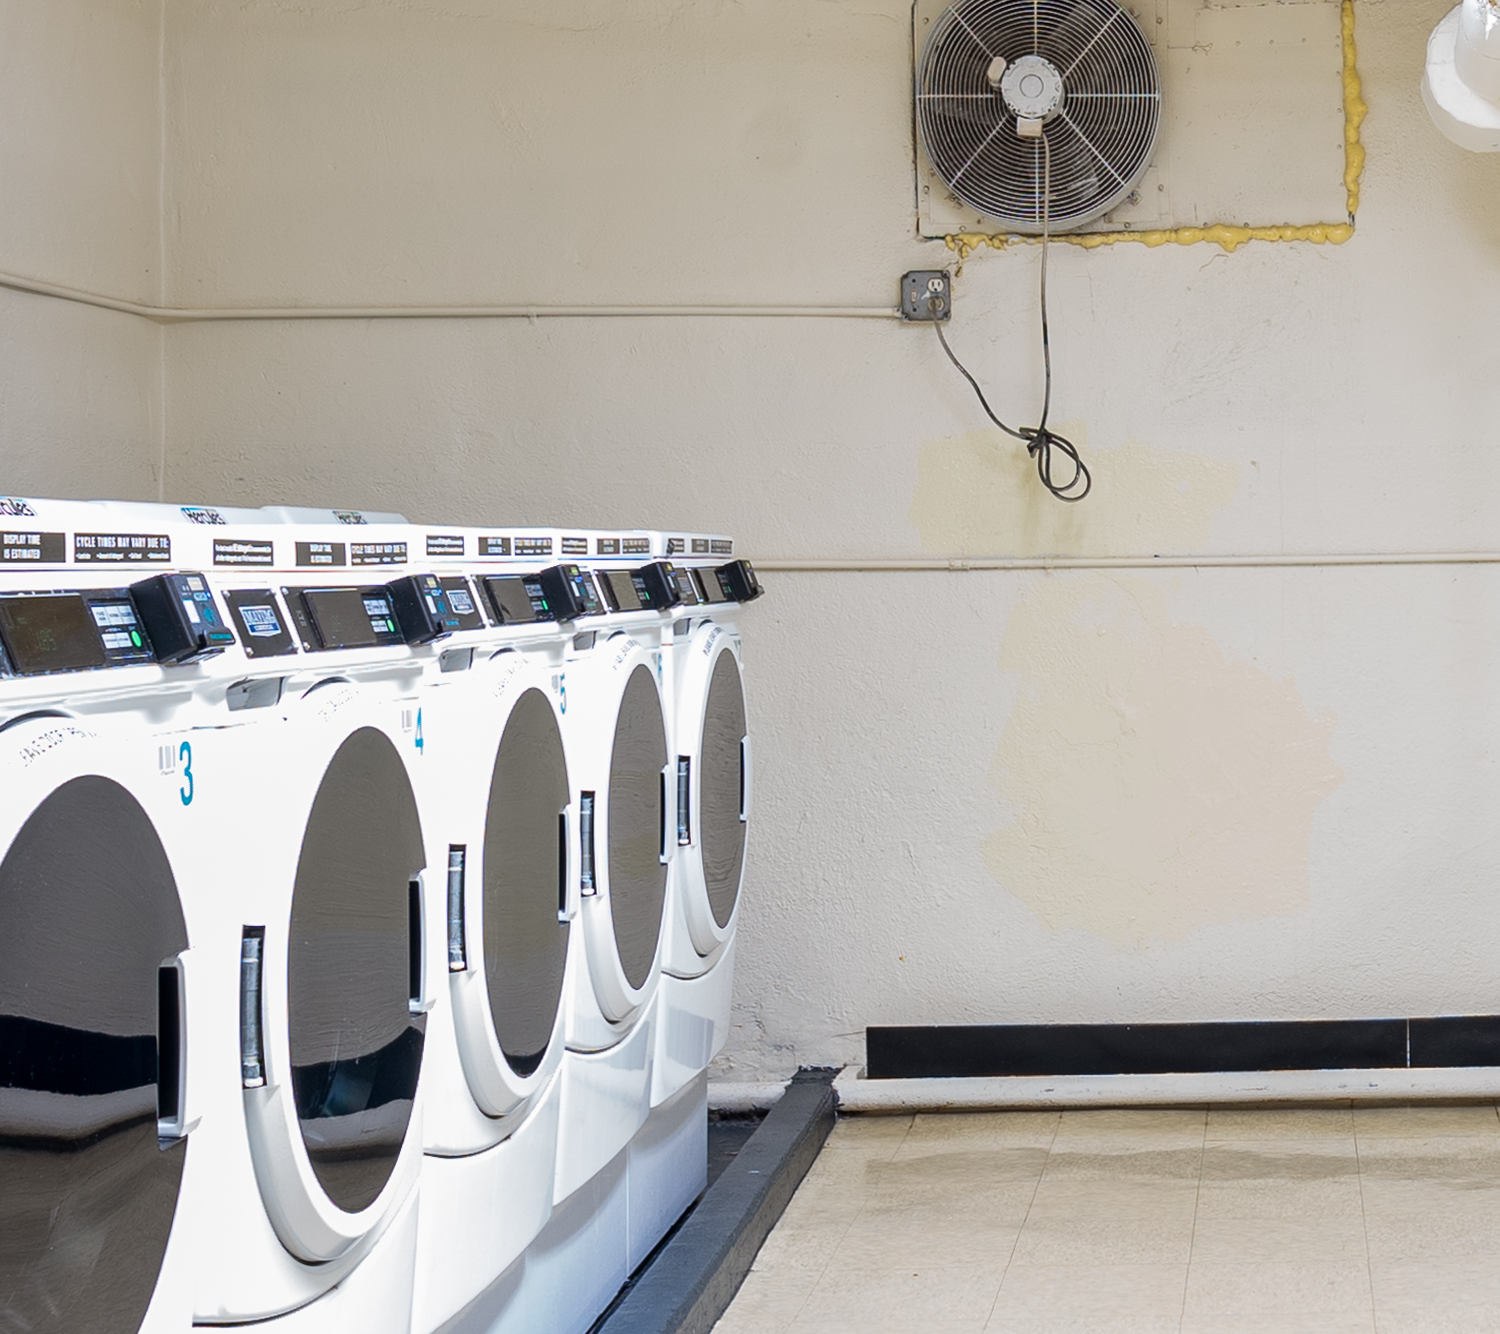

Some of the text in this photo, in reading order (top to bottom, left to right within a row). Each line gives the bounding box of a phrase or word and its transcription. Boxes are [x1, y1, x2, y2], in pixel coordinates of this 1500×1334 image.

[3, 534, 41, 545] DISPLAY TIME
[76, 536, 96, 548] CYCLE
[97, 536, 116, 548] TIMES
[11, 548, 41, 559] ESTIMATED
[415, 706, 424, 756] 4
[179, 741, 194, 806] 3
